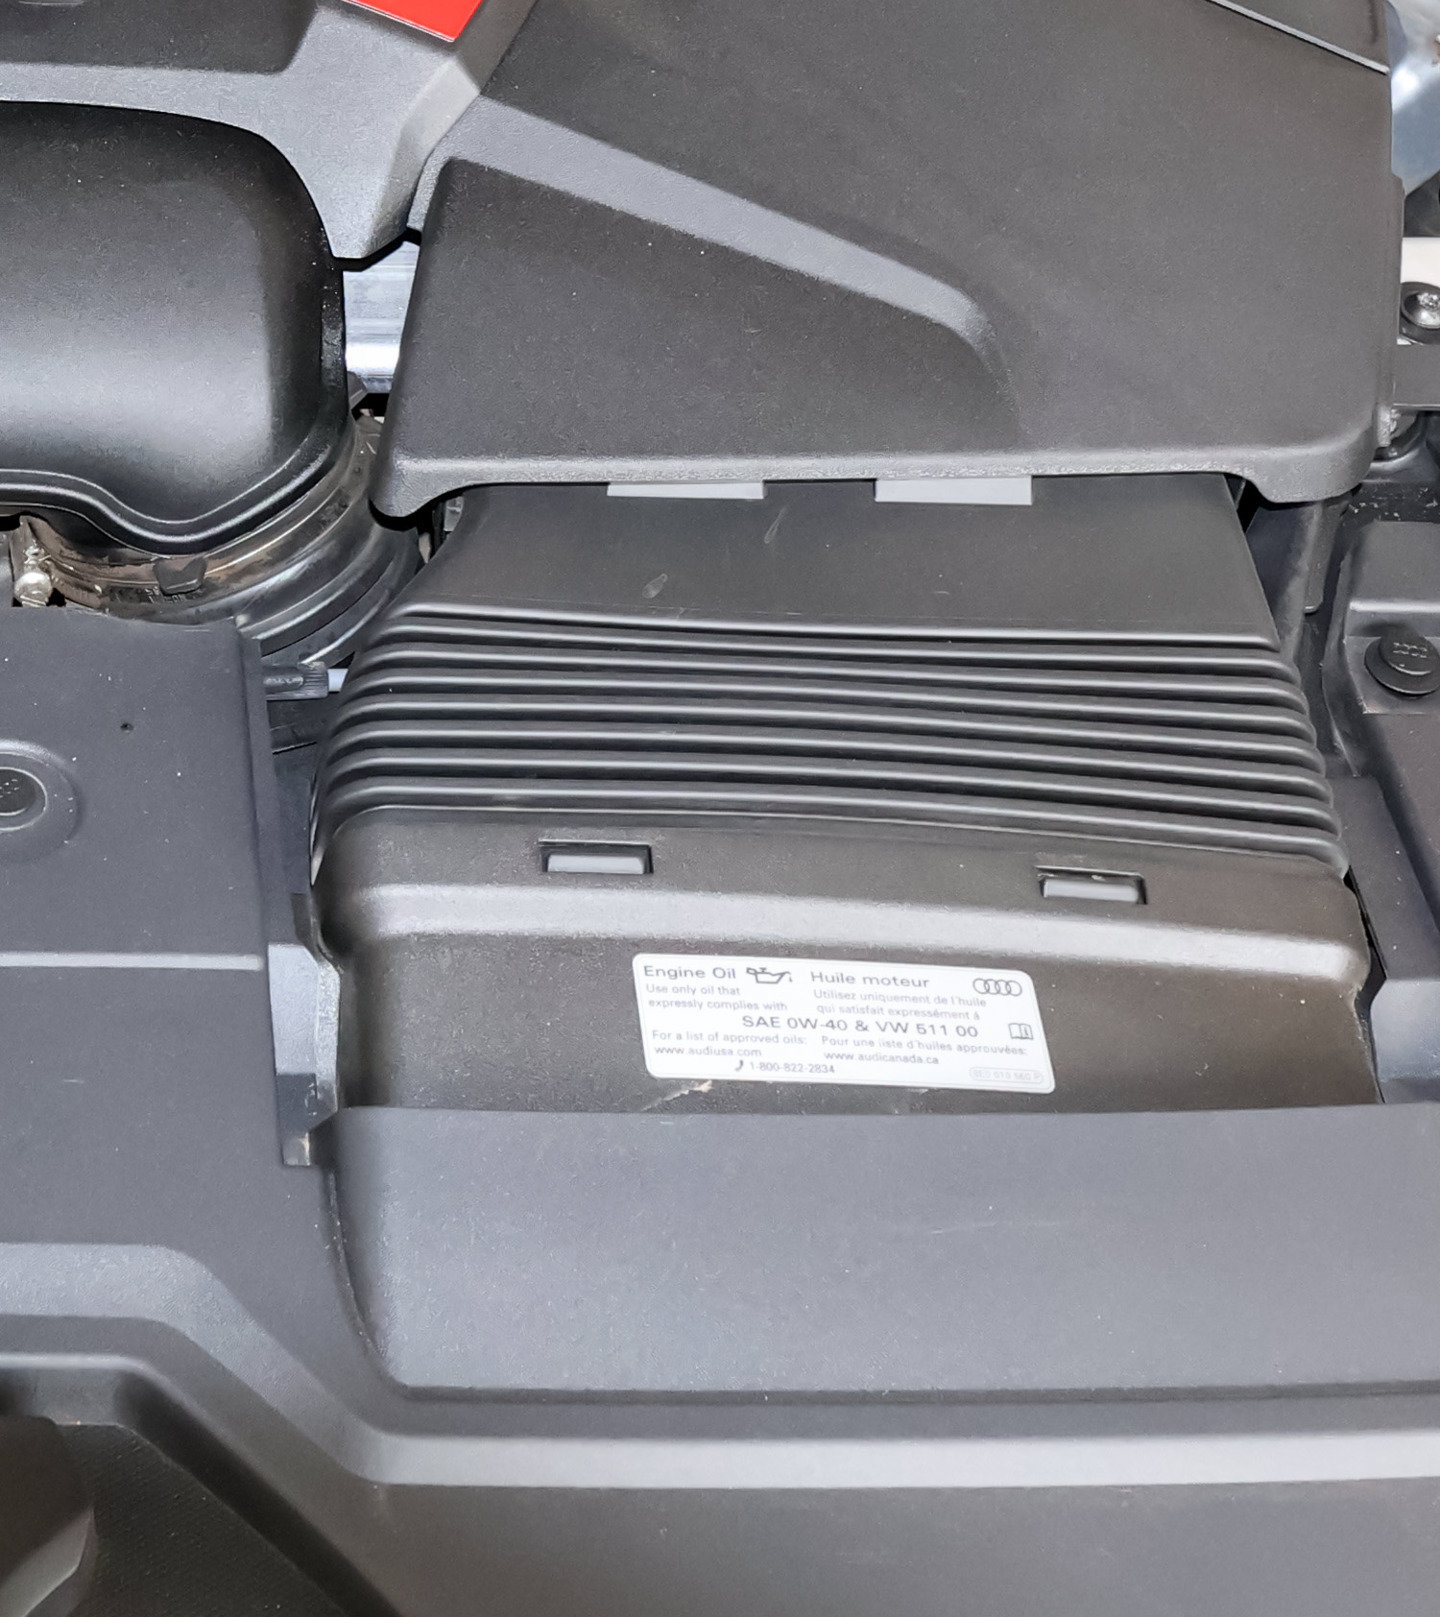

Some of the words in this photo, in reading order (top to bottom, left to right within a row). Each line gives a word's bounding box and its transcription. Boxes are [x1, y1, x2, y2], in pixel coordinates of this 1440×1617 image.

[644, 965, 705, 980] Engine
[712, 967, 736, 979] Oil
[810, 971, 855, 985] Huile
[862, 975, 930, 988] moteur
[646, 984, 668, 993] Use
[672, 985, 696, 996] only
[701, 986, 714, 995] oil
[718, 986, 740, 996] that
[814, 989, 856, 1001] Utilisez
[860, 992, 930, 1005] uniquement
[934, 995, 947, 1005] de
[648, 999, 703, 1010] expressly
[707, 1000, 759, 1011] complies
[763, 1002, 787, 1011] with
[817, 1004, 835, 1015] qui
[839, 1005, 884, 1016] satisfait
[888, 1007, 969, 1021] expressément
[742, 1015, 781, 1028] SAE
[787, 1017, 848, 1031] 0W-40
[855, 1020, 869, 1032] &
[875, 1020, 909, 1034] VW
[916, 1023, 947, 1036] 511
[956, 1025, 978, 1038] 00
[652, 1030, 671, 1041] For
[676, 1033, 682, 1041] a
[687, 1031, 703, 1041] list
[708, 1032, 719, 1042] of
[723, 1032, 779, 1045] approved
[821, 1035, 848, 1047] Pour
[853, 1038, 875, 1048] une
[879, 1037, 903, 1049] liste
[655, 1045, 762, 1057] www.audiusa.com
[823, 1051, 939, 1065] www.audicanada.ca
[749, 1062, 835, 1074] 1-800-822-2834
